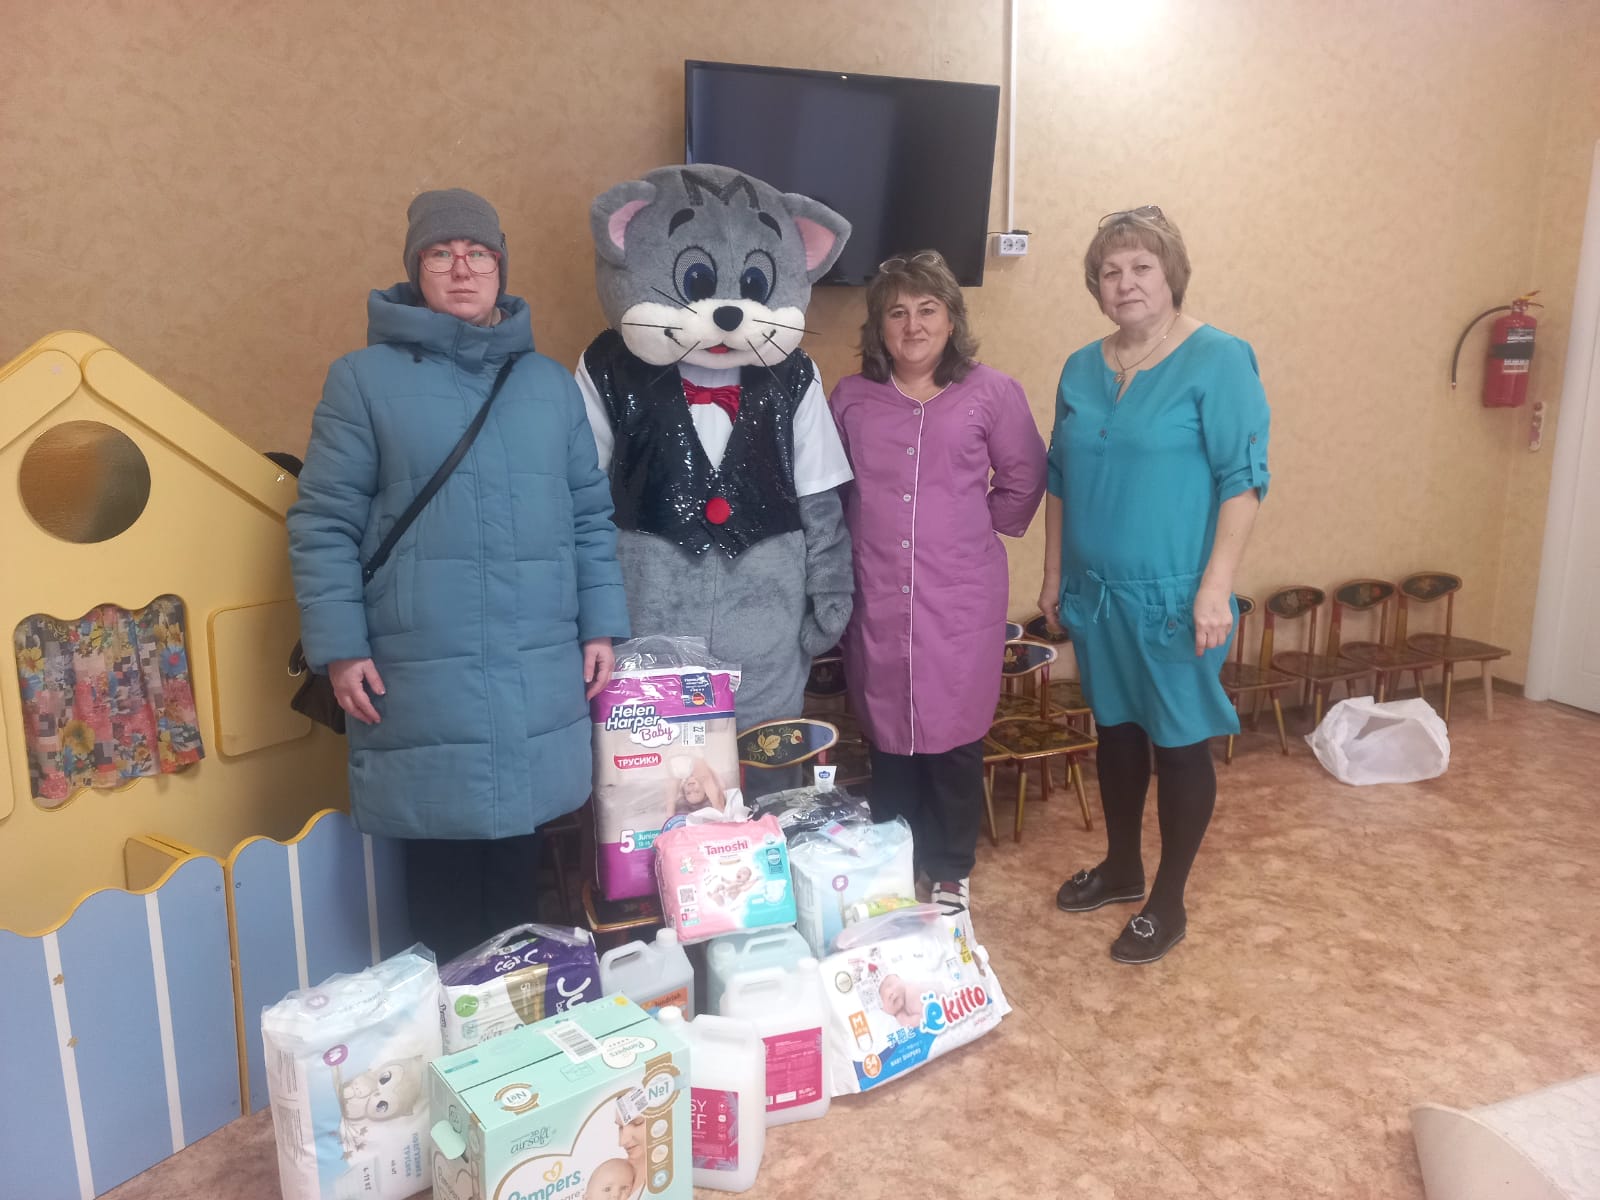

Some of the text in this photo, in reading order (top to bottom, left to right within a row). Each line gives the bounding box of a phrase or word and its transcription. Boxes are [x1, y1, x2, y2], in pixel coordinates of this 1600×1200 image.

[611, 703, 655, 719] Helen
[606, 715, 660, 733] Harper
[640, 724, 673, 741] Baby
[618, 755, 659, 767] ТРУСИКИ
[620, 829, 635, 853] 5
[704, 840, 749, 856] Tanoshi
